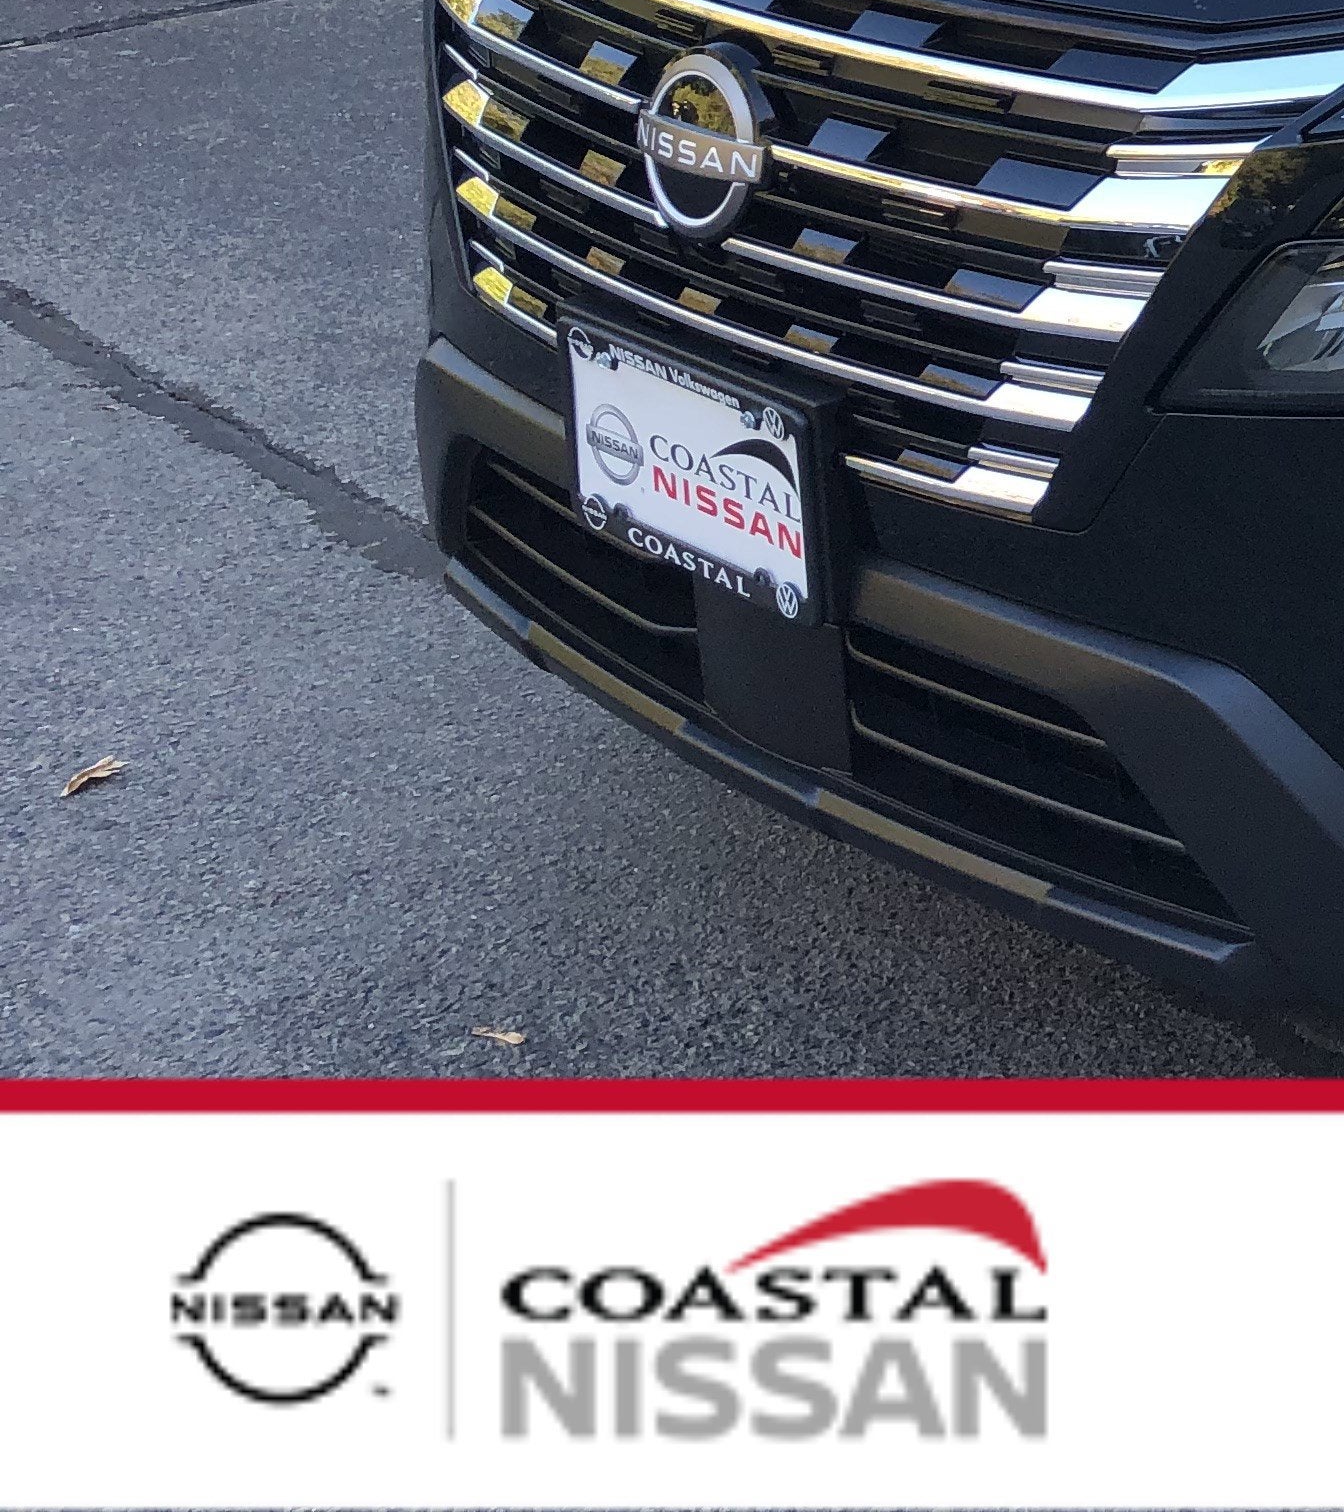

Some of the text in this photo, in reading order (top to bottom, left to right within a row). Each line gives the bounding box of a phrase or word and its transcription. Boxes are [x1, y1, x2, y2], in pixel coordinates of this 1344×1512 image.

[637, 118, 758, 178] NISSAN
[608, 343, 668, 380] NISSAN
[668, 366, 741, 409] Volkswagen
[591, 430, 639, 460] NISSAN
[650, 434, 801, 524] COASTAL
[652, 464, 802, 560] NISSAN
[627, 527, 751, 598] COASTAL
